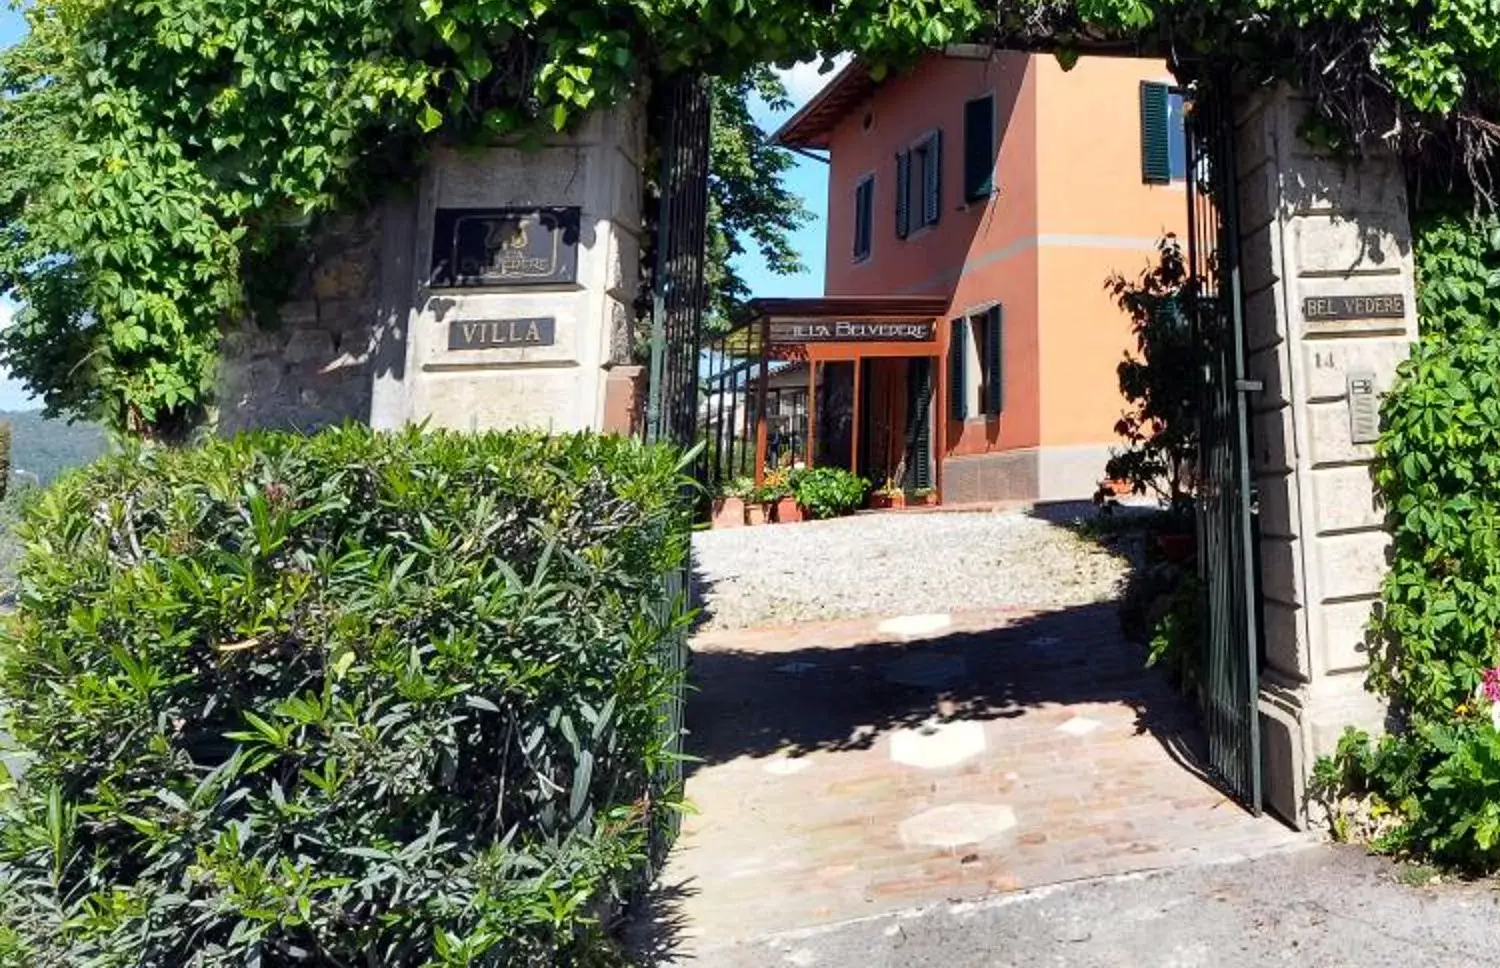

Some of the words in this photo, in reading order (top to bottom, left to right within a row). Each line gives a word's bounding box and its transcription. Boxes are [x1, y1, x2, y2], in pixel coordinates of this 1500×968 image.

[1307, 299, 1337, 316] BEL
[1344, 297, 1404, 314] VEDERE
[462, 320, 541, 344] VILLA
[785, 323, 831, 337] ILLA
